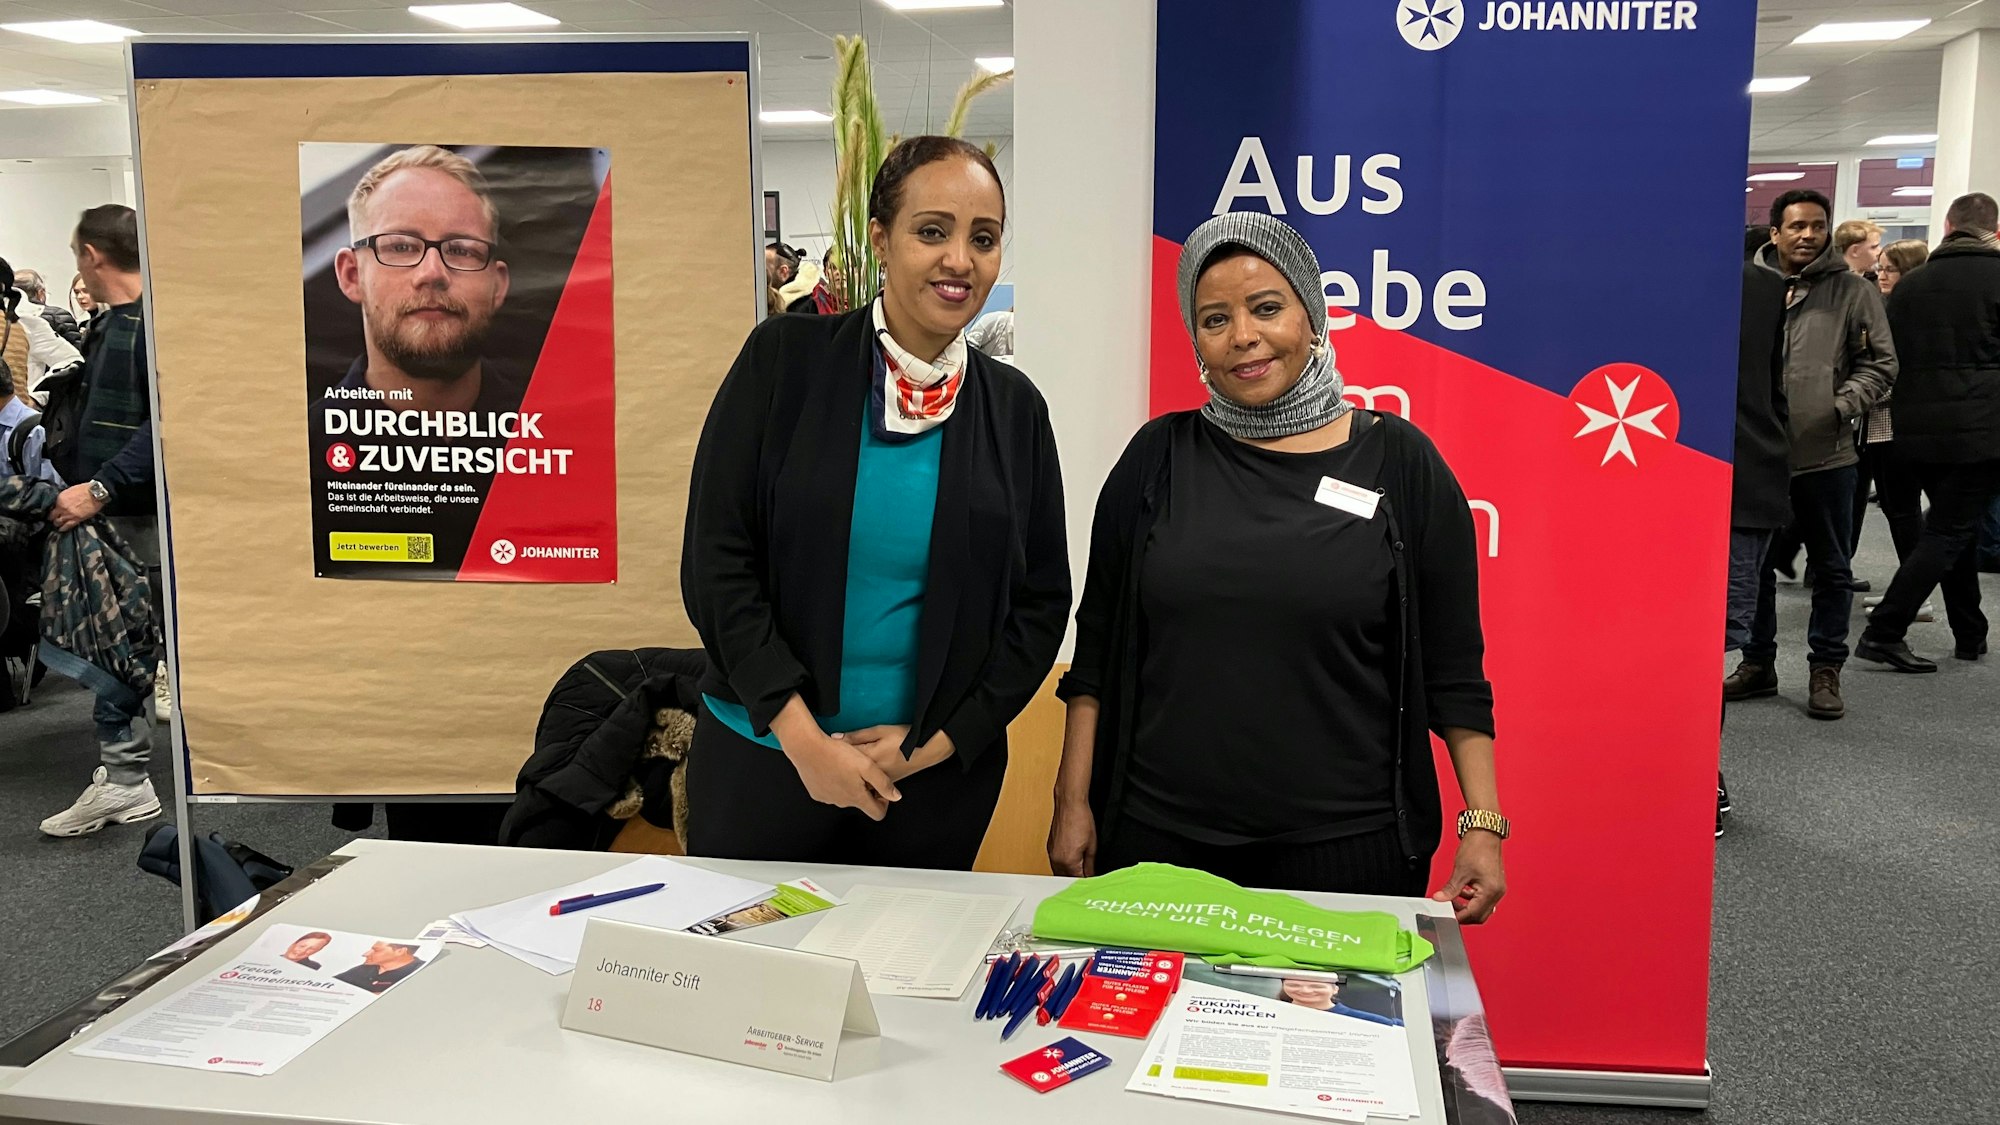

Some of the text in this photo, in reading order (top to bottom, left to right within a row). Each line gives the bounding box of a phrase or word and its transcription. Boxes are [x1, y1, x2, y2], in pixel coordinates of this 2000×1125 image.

[1478, 0, 1697, 31] JOHANNITER
[1211, 136, 1404, 215] Aus
[1322, 250, 1488, 331] ebe
[324, 386, 413, 401] Arbeiten mit
[324, 408, 544, 439] DURCHBLICK
[332, 445, 574, 475] & ZUVERSICHT
[326, 480, 476, 493] Miteinander füreinander da sein.
[327, 492, 480, 504] Das ist die Arbeitsweise, die unsere
[328, 503, 434, 514] Gemeinschaft verbindet.
[336, 542, 400, 552] Jetzt bewerben
[520, 546, 600, 559] JOHANNITER
[1084, 898, 1361, 944] JOHANNITER PFLEGEN
[1169, 914, 1210, 926] DIE
[1220, 919, 1343, 951] UMWELT.
[232, 964, 283, 976] Freude
[596, 957, 701, 992] Johanniter Stift
[1096, 966, 1151, 979] JOHANNITER
[237, 972, 336, 989] Gemeinschaft
[586, 996, 603, 1012] 18
[1189, 1000, 1260, 1010] ZUKUNFT
[1202, 1007, 1276, 1019] CHANCEN
[1050, 1051, 1098, 1075] JOHANNITER
